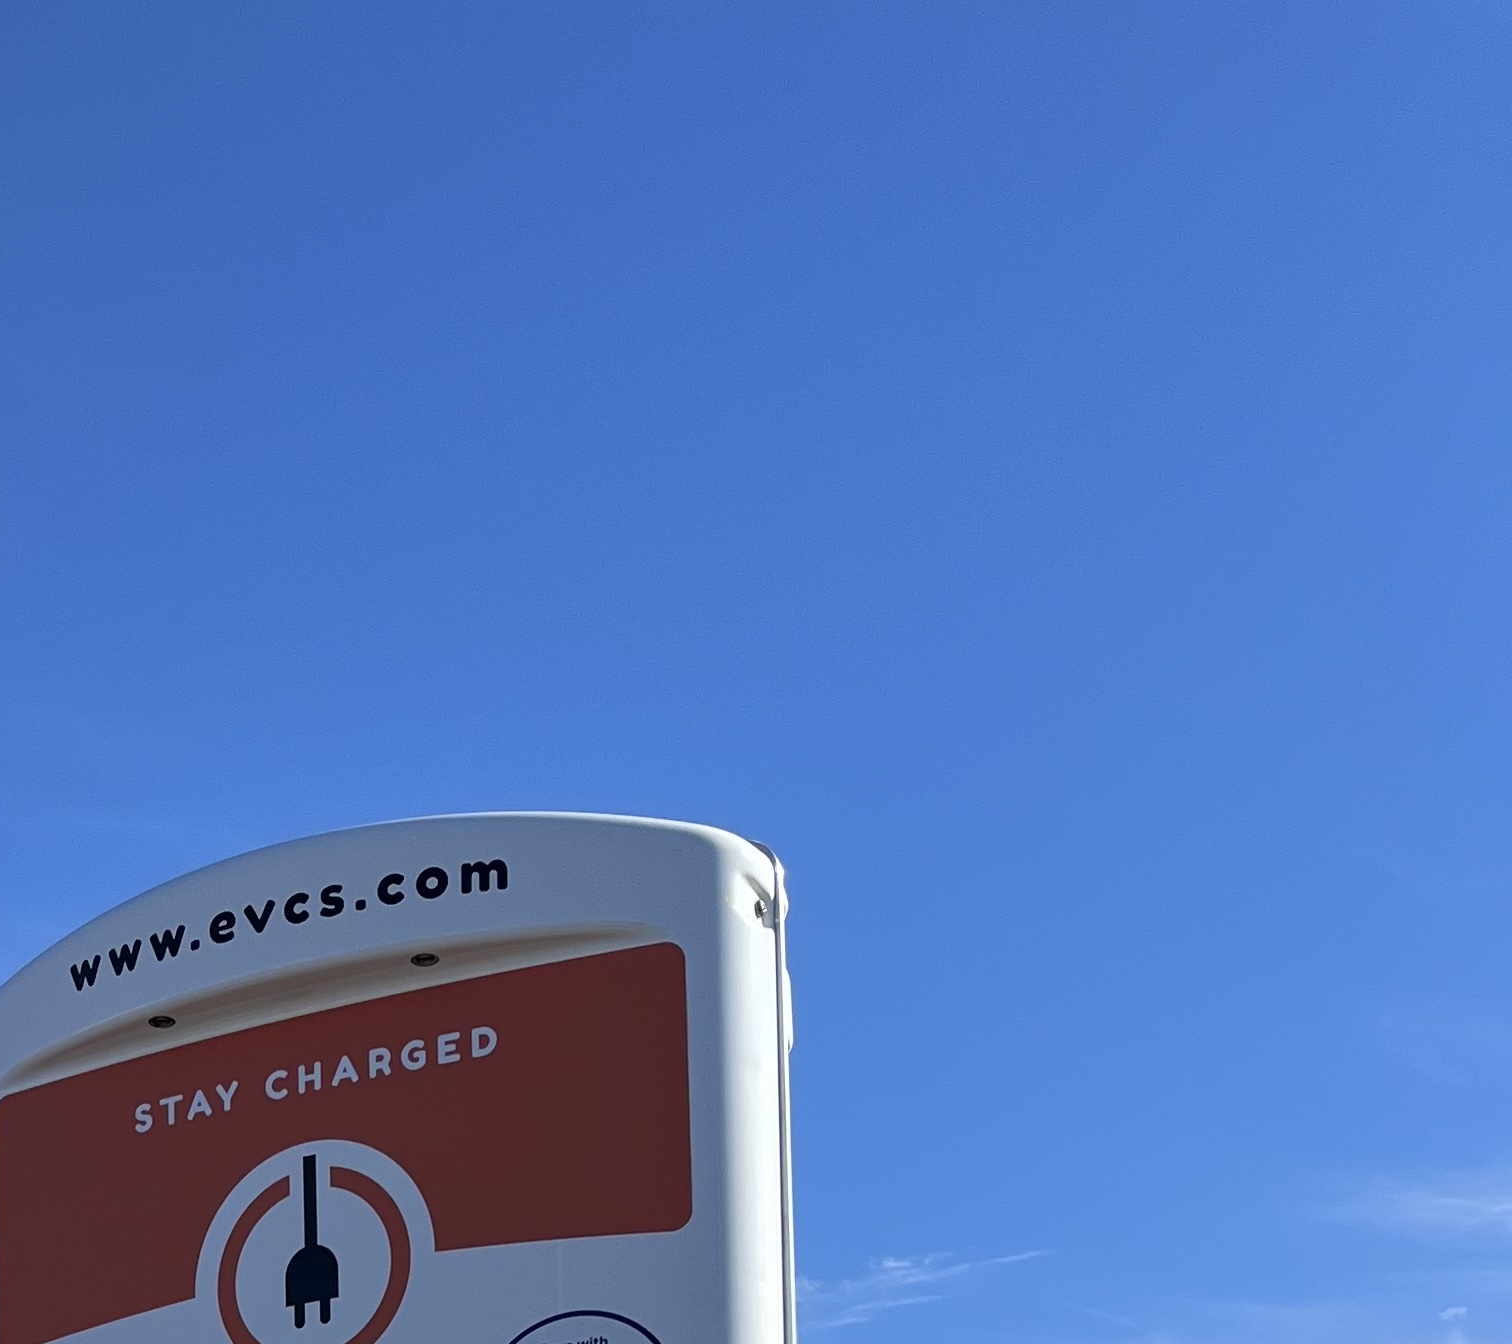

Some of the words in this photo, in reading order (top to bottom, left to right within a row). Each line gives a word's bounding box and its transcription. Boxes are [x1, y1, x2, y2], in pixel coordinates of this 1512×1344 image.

[69, 858, 509, 992] www.evcs.com
[134, 1079, 239, 1134] STAY
[264, 1025, 499, 1101] CHARGED
